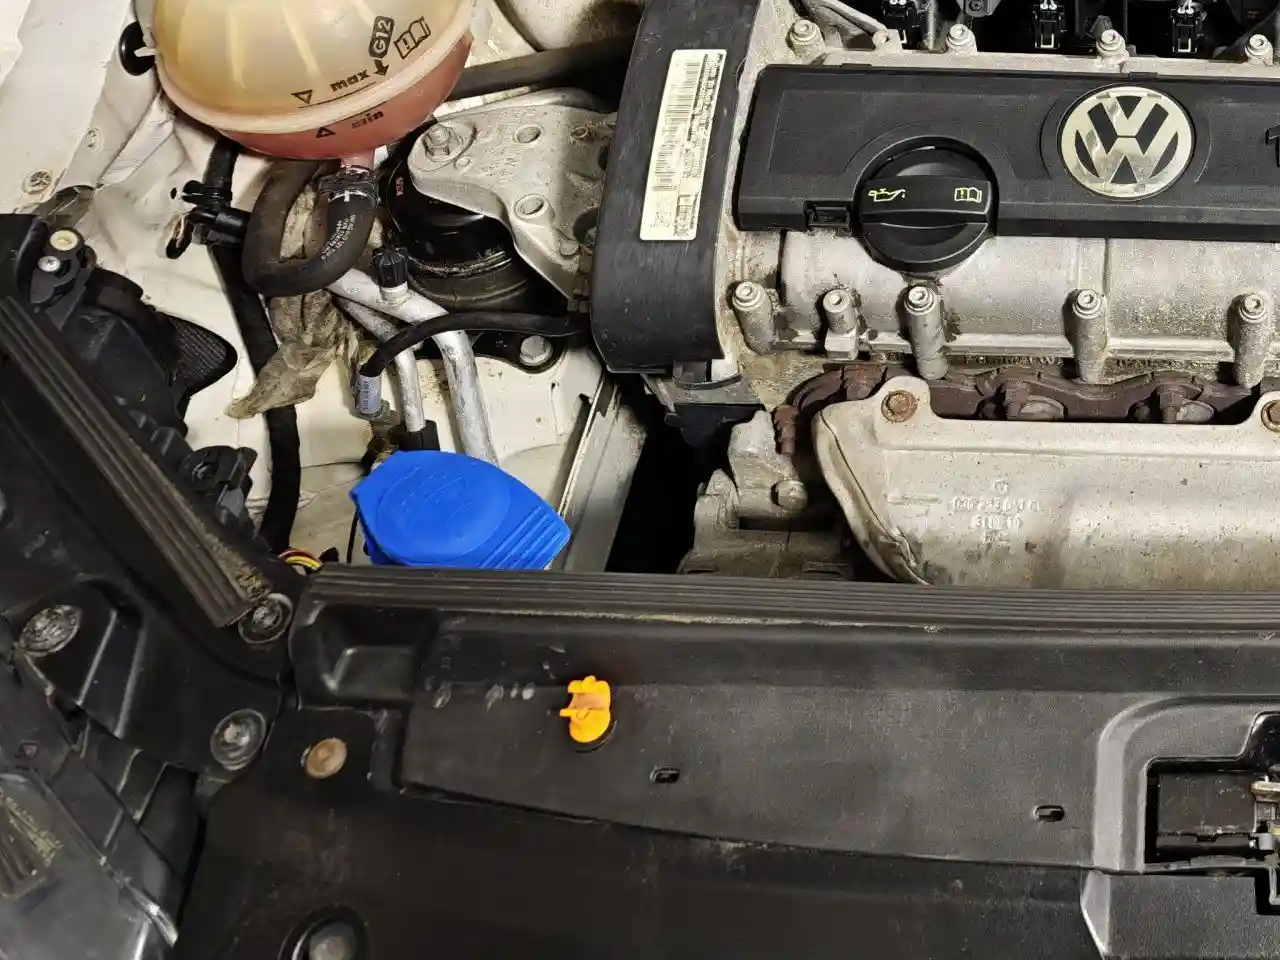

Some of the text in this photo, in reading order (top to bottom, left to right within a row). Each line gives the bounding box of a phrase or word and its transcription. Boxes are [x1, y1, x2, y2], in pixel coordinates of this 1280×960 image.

[372, 17, 393, 54] G12
[330, 69, 370, 92] max
[352, 111, 385, 129] min
[1061, 86, 1192, 198] VW
